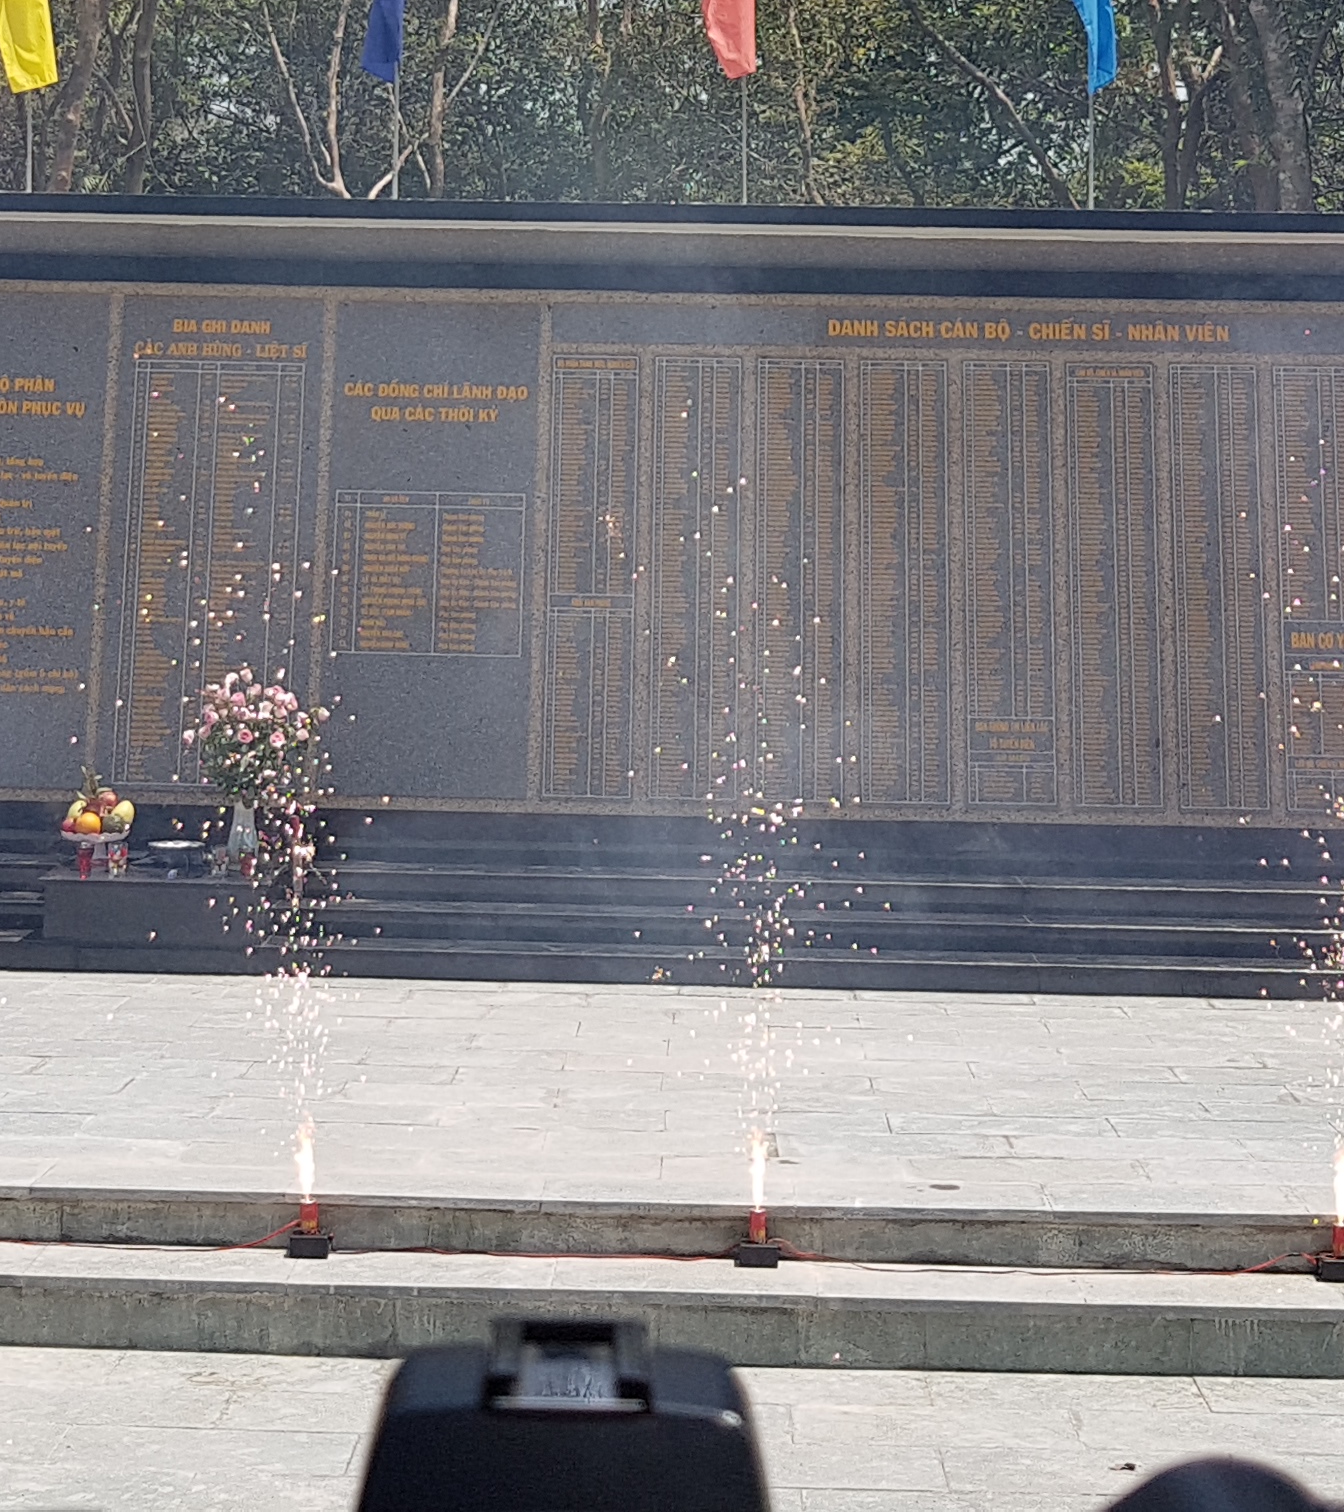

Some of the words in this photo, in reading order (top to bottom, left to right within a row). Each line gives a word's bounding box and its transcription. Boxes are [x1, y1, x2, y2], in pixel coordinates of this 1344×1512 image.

[173, 319, 197, 333] BIA
[201, 320, 226, 334] GHI
[230, 320, 271, 334] DANH
[828, 319, 879, 337] DANH
[884, 316, 935, 338] SÁCH
[940, 317, 978, 338] CÁN
[984, 318, 1012, 342] BỘ
[1028, 317, 1087, 341] CHIẾN
[1092, 319, 1111, 341] SĨ
[1128, 320, 1180, 342] NHÂN
[1184, 321, 1230, 343] VIÊN
[167, 342, 197, 356] ANH
[201, 340, 242, 357] HÙNG
[256, 341, 289, 360] LIỆT
[344, 379, 374, 397] CÁC
[378, 379, 419, 398] ĐỒNG
[423, 380, 449, 398] CHÍ
[453, 382, 492, 399] LÃNH
[497, 385, 528, 402] ĐẠO
[22, 400, 61, 417] PHỤC
[65, 402, 86, 418] VỤ
[370, 406, 400, 422] QUA
[405, 403, 435, 421] CÁC
[440, 405, 474, 422] THỜI
[1291, 631, 1315, 648] BAN
